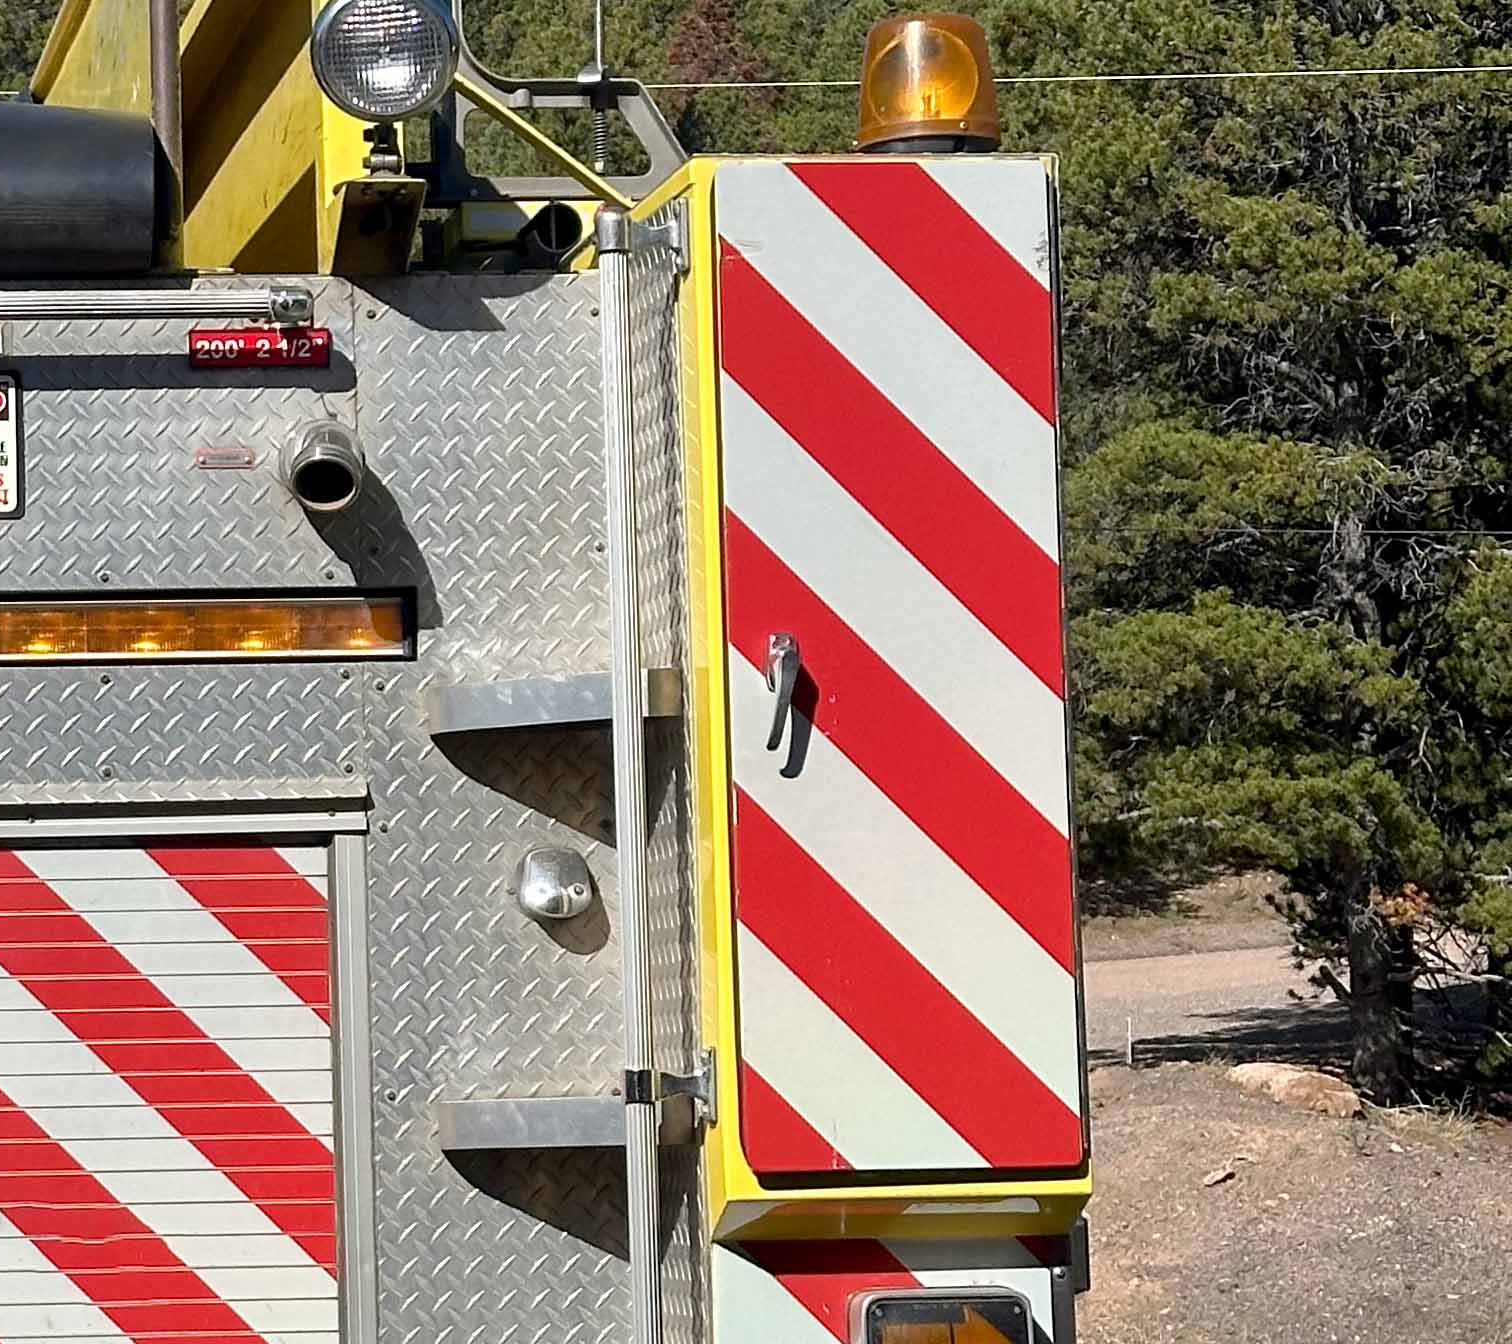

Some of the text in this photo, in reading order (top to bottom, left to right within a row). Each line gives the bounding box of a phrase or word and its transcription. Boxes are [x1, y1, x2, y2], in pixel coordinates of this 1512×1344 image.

[196, 338, 324, 359] 200' 2 1/2"
